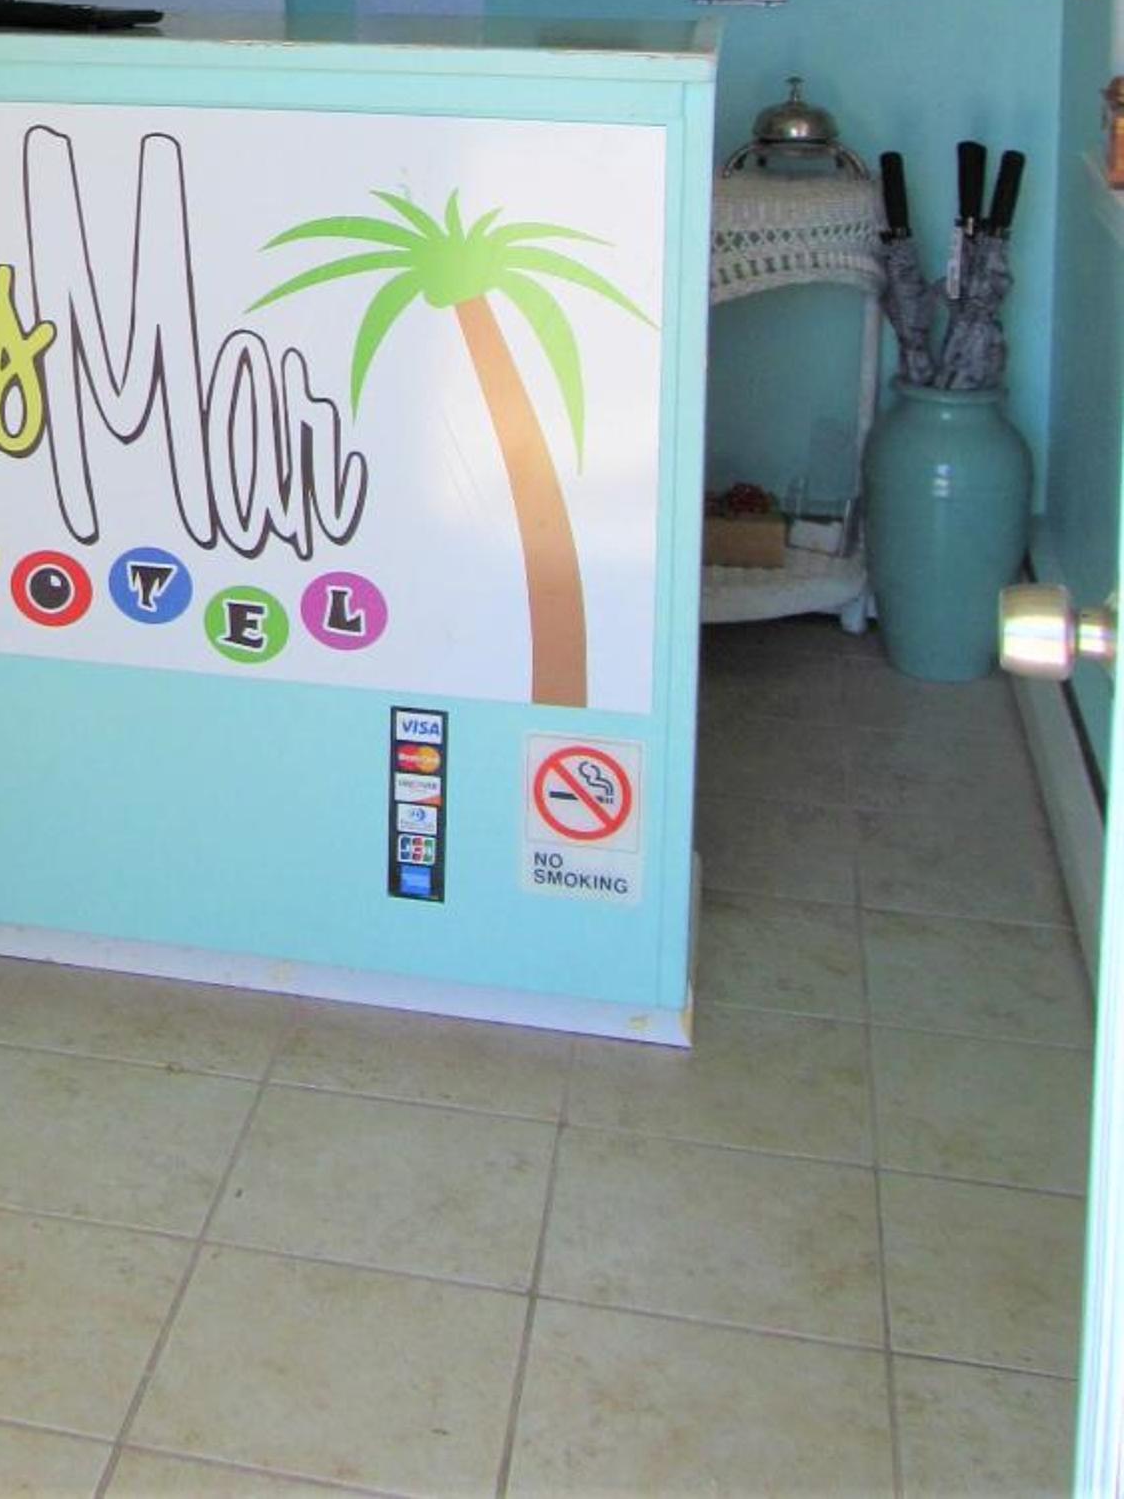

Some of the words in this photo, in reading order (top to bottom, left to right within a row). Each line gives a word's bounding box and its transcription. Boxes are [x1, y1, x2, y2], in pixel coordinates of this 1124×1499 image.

[402, 719, 439, 735] VISA
[534, 852, 563, 868] NO
[533, 868, 628, 894] SMOKING
